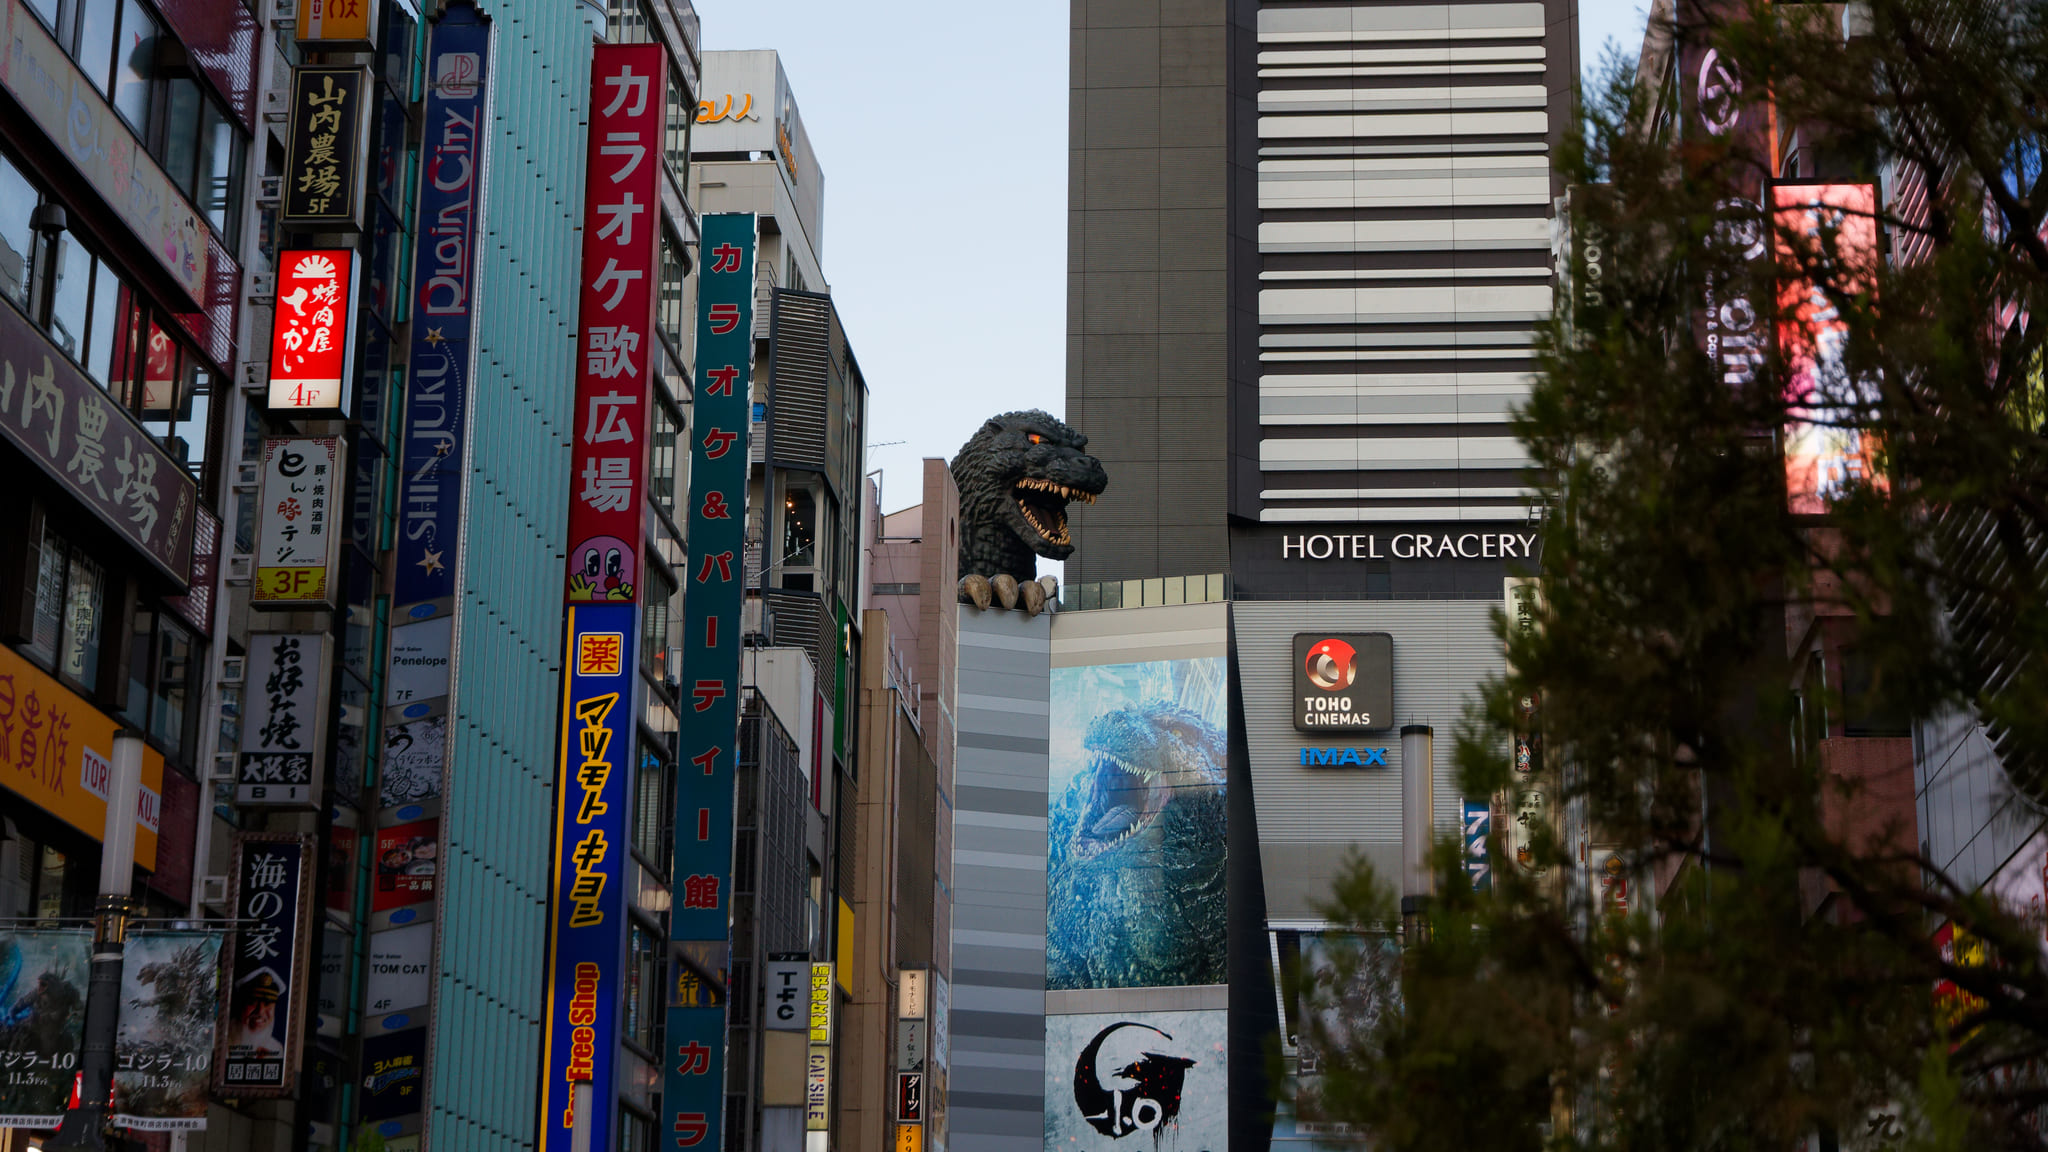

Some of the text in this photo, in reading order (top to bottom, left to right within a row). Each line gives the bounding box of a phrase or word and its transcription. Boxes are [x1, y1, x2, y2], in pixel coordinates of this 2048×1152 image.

[299, 75, 346, 197] 山内農場
[308, 199, 330, 214] 5F
[580, 65, 650, 513] カラオケ歌広場
[281, 287, 308, 373] さかい
[308, 279, 341, 353] 焼肉屋
[287, 383, 321, 407] 4F
[1283, 534, 1536, 559] HOTEL GRACERY
[273, 570, 311, 594] 3F
[394, 655, 447, 667] Penelope
[583, 637, 618, 671] 薬
[260, 637, 303, 749] お好み焼
[397, 690, 413, 700] 7F
[1304, 697, 1352, 711] TOHO
[1304, 713, 1371, 725] CINEMAS
[242, 755, 307, 783] 大阪家
[1300, 748, 1388, 766] IMAX
[569, 692, 620, 928] マツモトキヨシ
[245, 852, 287, 960] 海の家
[373, 963, 427, 975] TOM CAT
[374, 1000, 391, 1010] 4F
[570, 962, 600, 1026] Shop
[777, 971, 798, 1020] TFC
[566, 1027, 595, 1081] Free
[674, 1041, 711, 1146] カラ
[808, 1054, 825, 1120] CAPSULE
[908, 1076, 920, 1111] ダーツ
